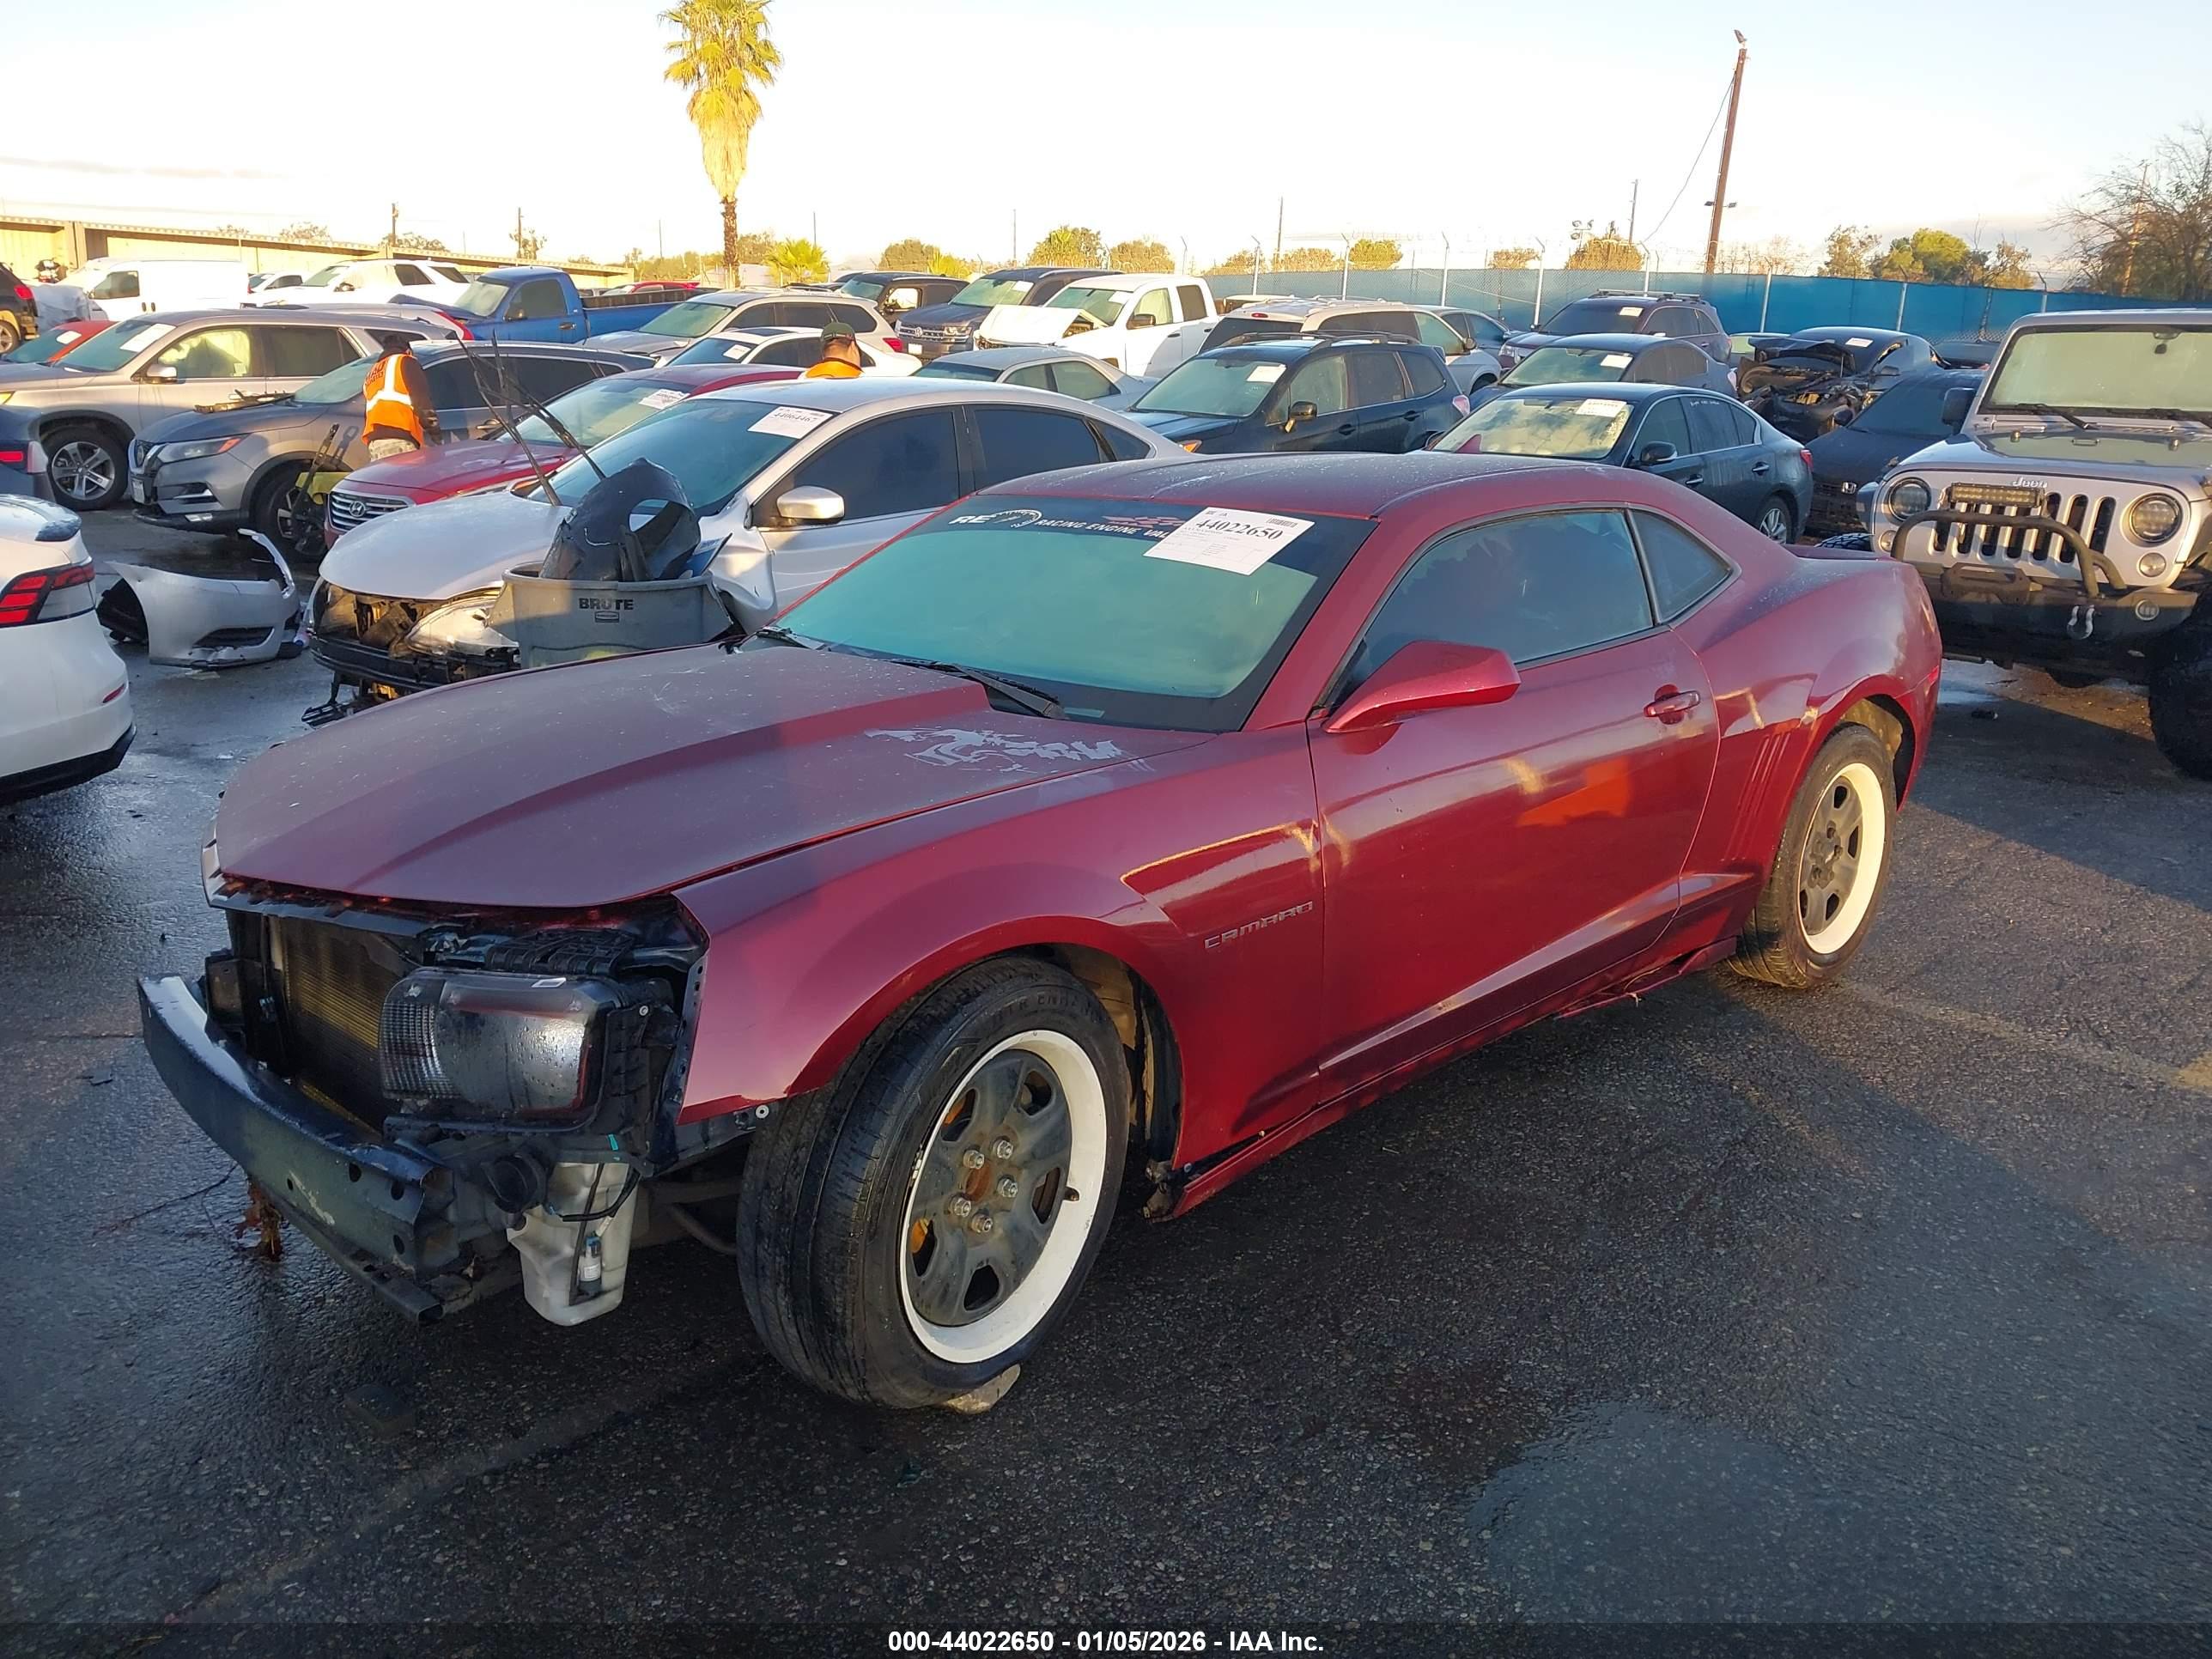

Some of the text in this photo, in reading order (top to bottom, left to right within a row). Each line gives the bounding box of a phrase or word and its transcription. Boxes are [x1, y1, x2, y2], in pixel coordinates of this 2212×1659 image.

[1034, 519, 1087, 529] RACING
[1085, 523, 1142, 534] ENGINE
[1195, 518, 1285, 540] 44022650
[578, 597, 634, 611] BRUTE
[1204, 901, 1313, 949] CAMARO
